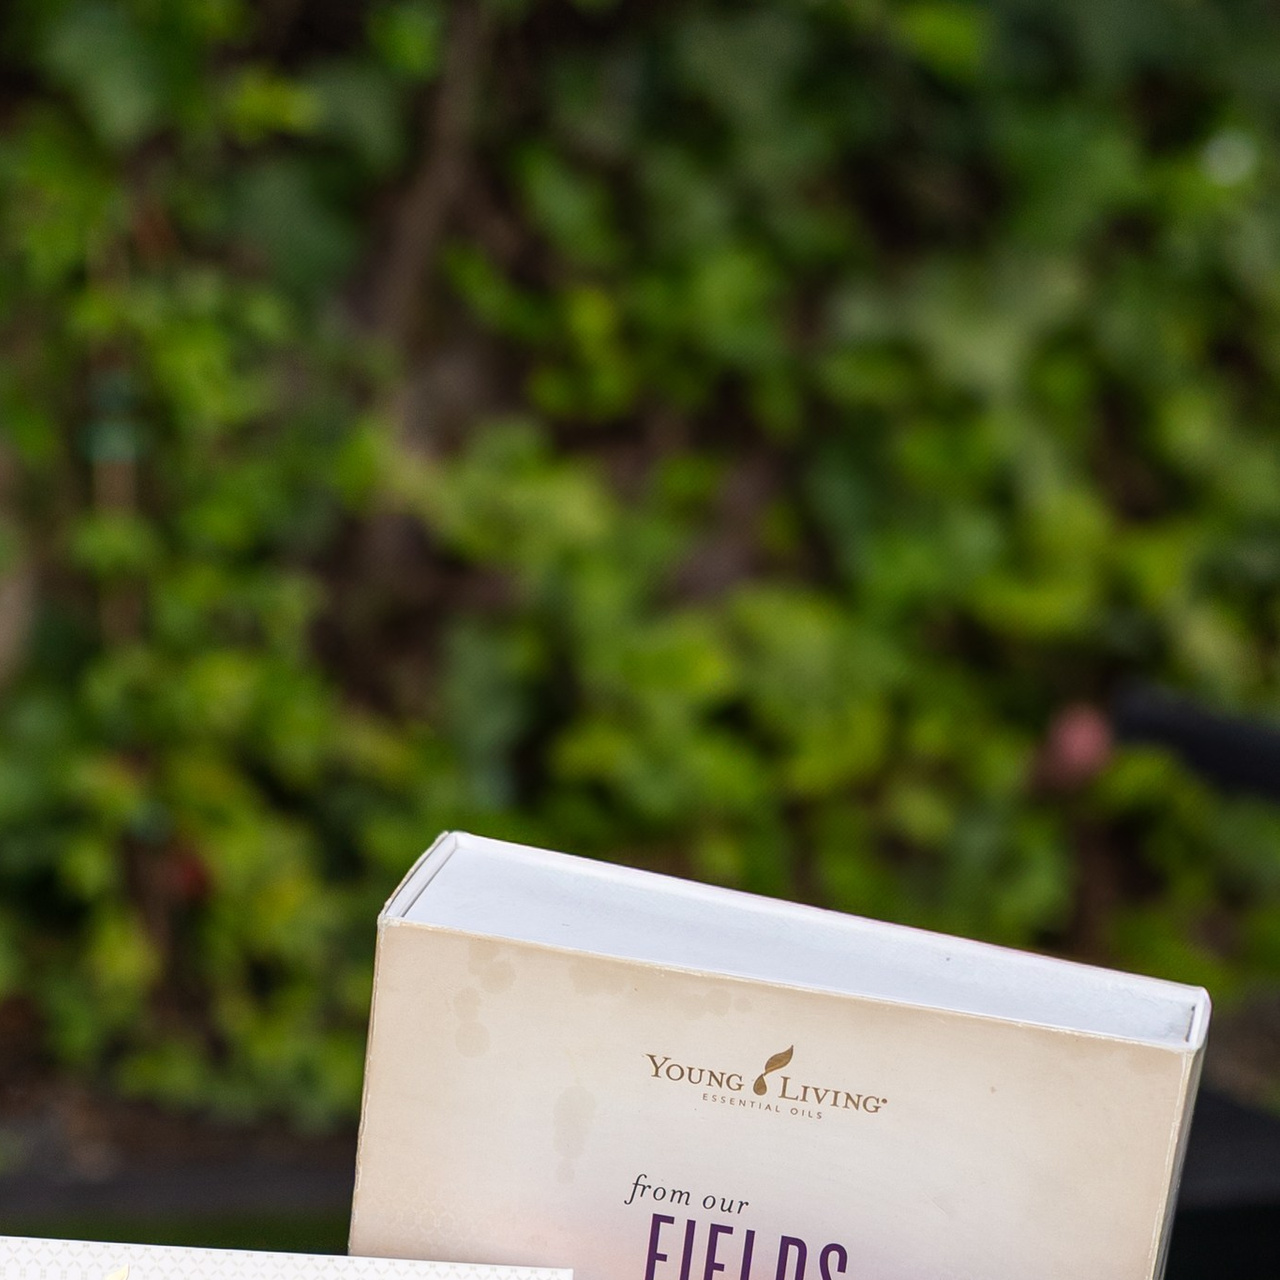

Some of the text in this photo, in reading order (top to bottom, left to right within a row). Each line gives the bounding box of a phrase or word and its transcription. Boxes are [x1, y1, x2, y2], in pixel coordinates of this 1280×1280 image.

[646, 1054, 744, 1091] YOUNG
[703, 1093, 822, 1119] ESSENTIAL OILS
[624, 1174, 749, 1214] from our
